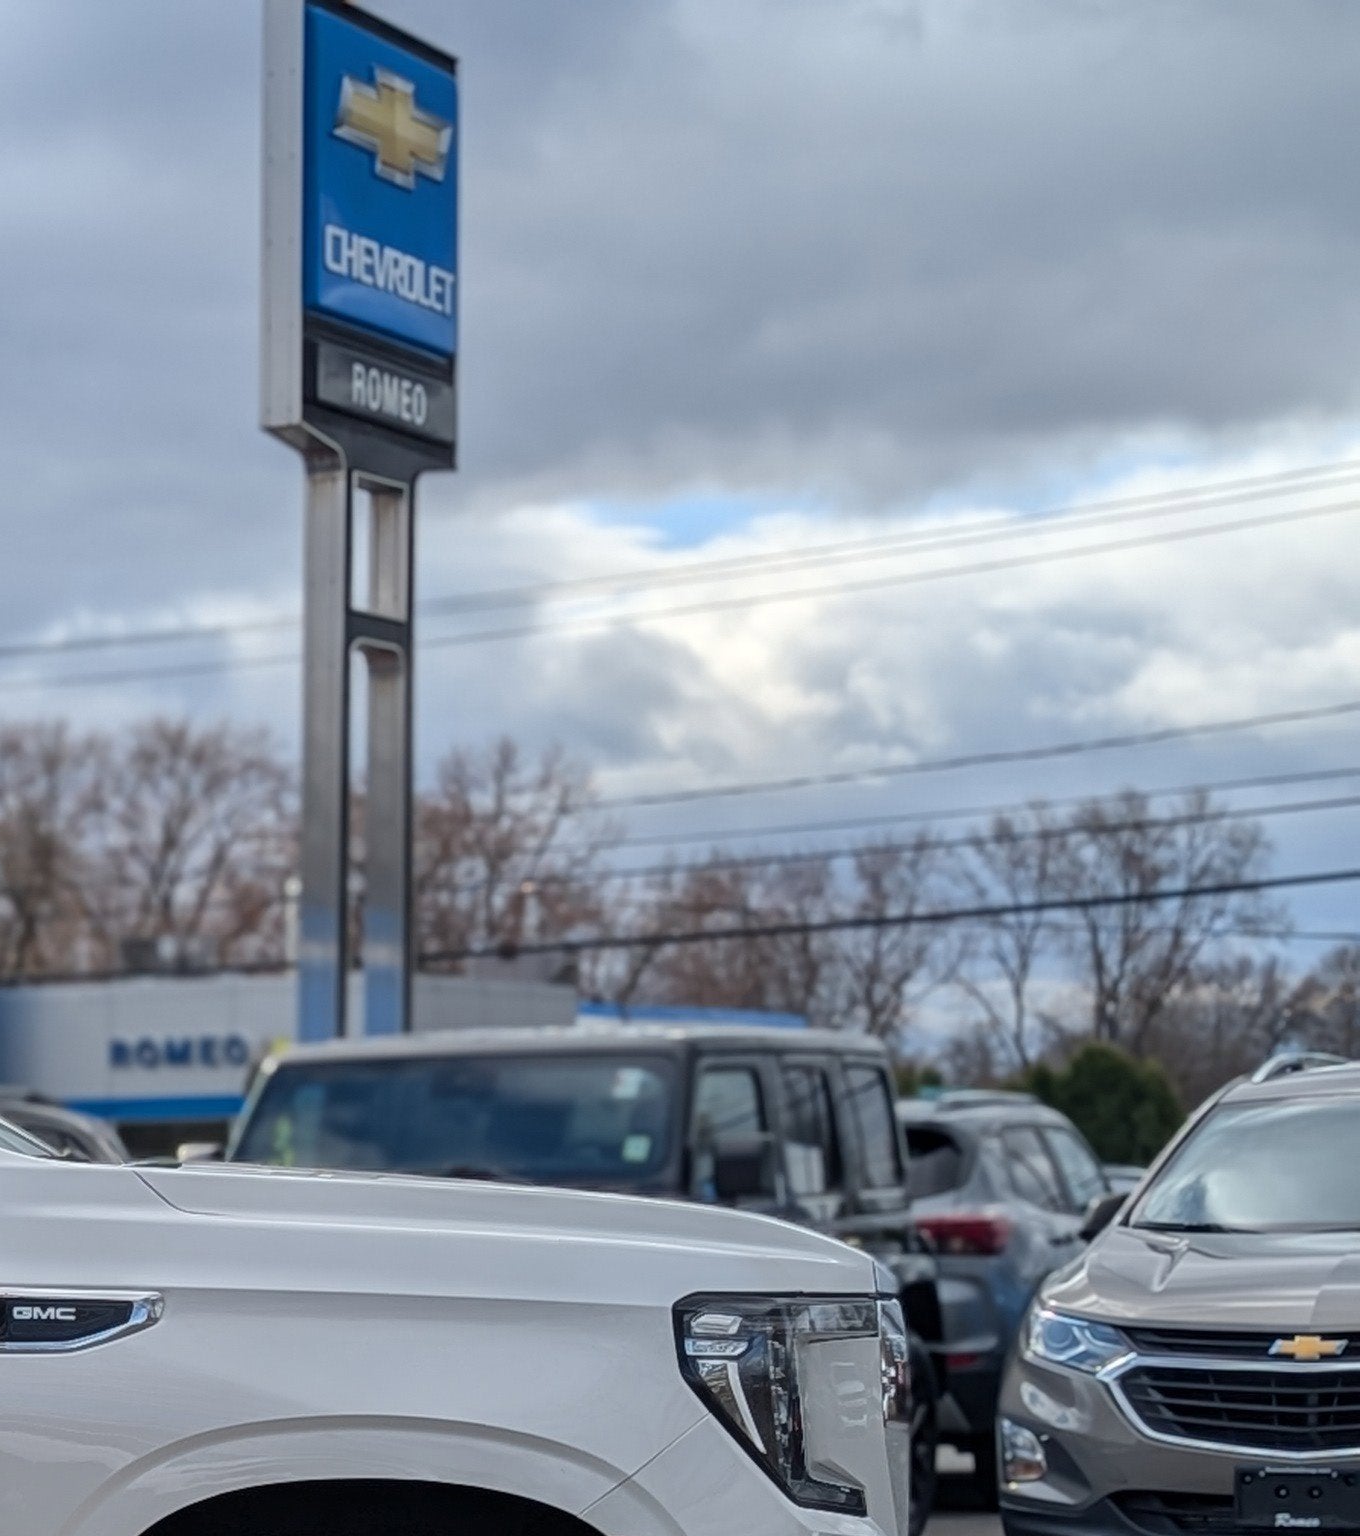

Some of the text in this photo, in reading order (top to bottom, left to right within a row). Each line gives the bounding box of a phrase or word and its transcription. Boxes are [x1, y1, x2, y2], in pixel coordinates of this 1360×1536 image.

[324, 223, 455, 315] CHEVROLET
[352, 362, 428, 427] ROMEO
[109, 1035, 249, 1069] ROMEO
[12, 1305, 77, 1321] GMC
